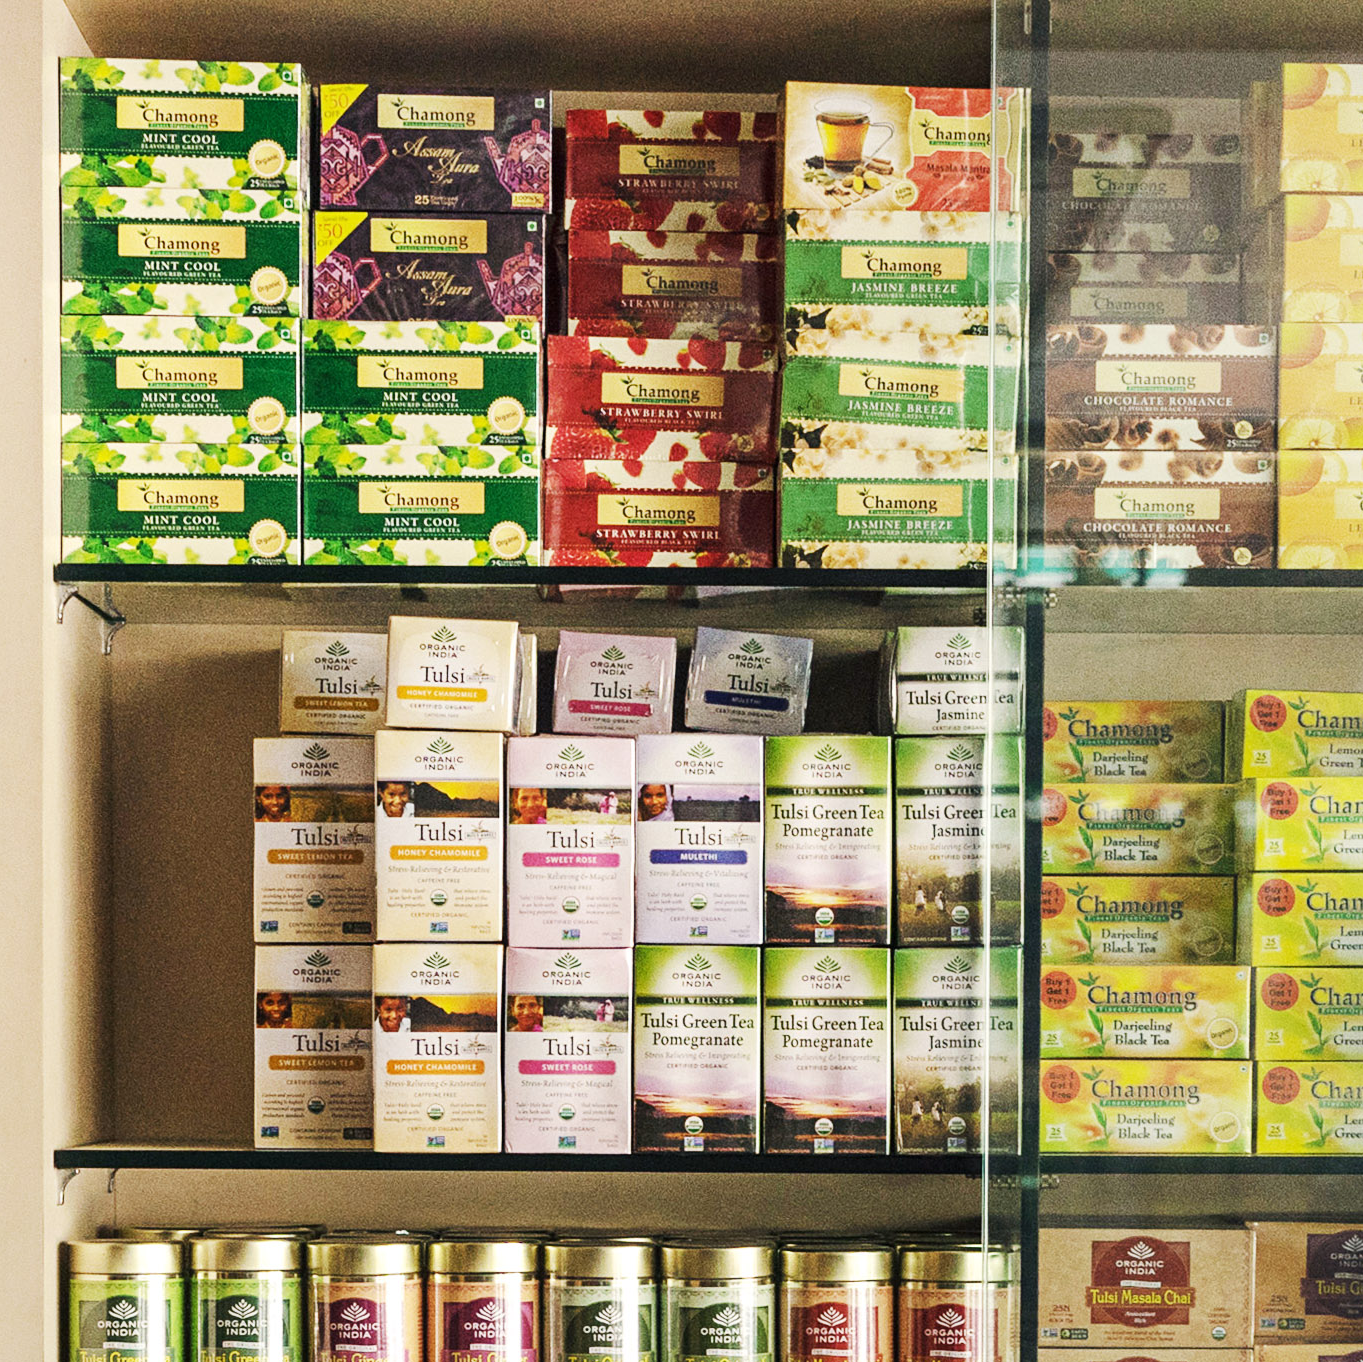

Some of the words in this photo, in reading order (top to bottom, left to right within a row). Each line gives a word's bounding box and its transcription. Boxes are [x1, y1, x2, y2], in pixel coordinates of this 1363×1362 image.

[142, 108, 219, 128] Chamong
[397, 106, 476, 126] Chamong
[143, 134, 177, 144] MINT
[181, 134, 219, 145] COOL
[392, 135, 456, 159] Assam
[867, 257, 942, 277] Chamong
[851, 281, 907, 294] JASMINE
[910, 282, 958, 294] BREEZE
[1121, 370, 1196, 392] Chamong
[626, 385, 700, 404] Chamong
[1084, 396, 1163, 407] CHOCOLATE
[1168, 396, 1232, 407] ROMANCE
[600, 408, 679, 419] STRAWBERRY
[415, 756, 463, 764] ORGANIC
[425, 762, 456, 771] INDIA
[772, 804, 808, 820] Tulsi
[812, 805, 856, 820] Green
[859, 806, 884, 820] Tea
[415, 824, 463, 842] Tulsi
[675, 827, 723, 846] Tulsi
[783, 824, 874, 840] Pomegranate
[547, 831, 595, 849] Tulsi
[398, 848, 427, 858] HONEY
[430, 848, 481, 858] CHAMOMILE
[546, 855, 574, 865] SWEET
[576, 855, 598, 864] ROSE
[680, 852, 717, 861] MULETHI
[1088, 986, 1197, 1010] Chamong
[1113, 1020, 1172, 1033] Darjeeling
[1114, 1034, 1149, 1045] Black
[1152, 1035, 1170, 1045] Tea
[1115, 1260, 1164, 1268] ORGANIC
[1091, 1291, 1119, 1305] Tulsi
[1122, 1292, 1158, 1305] Masala
[1161, 1291, 1191, 1305] Chai
